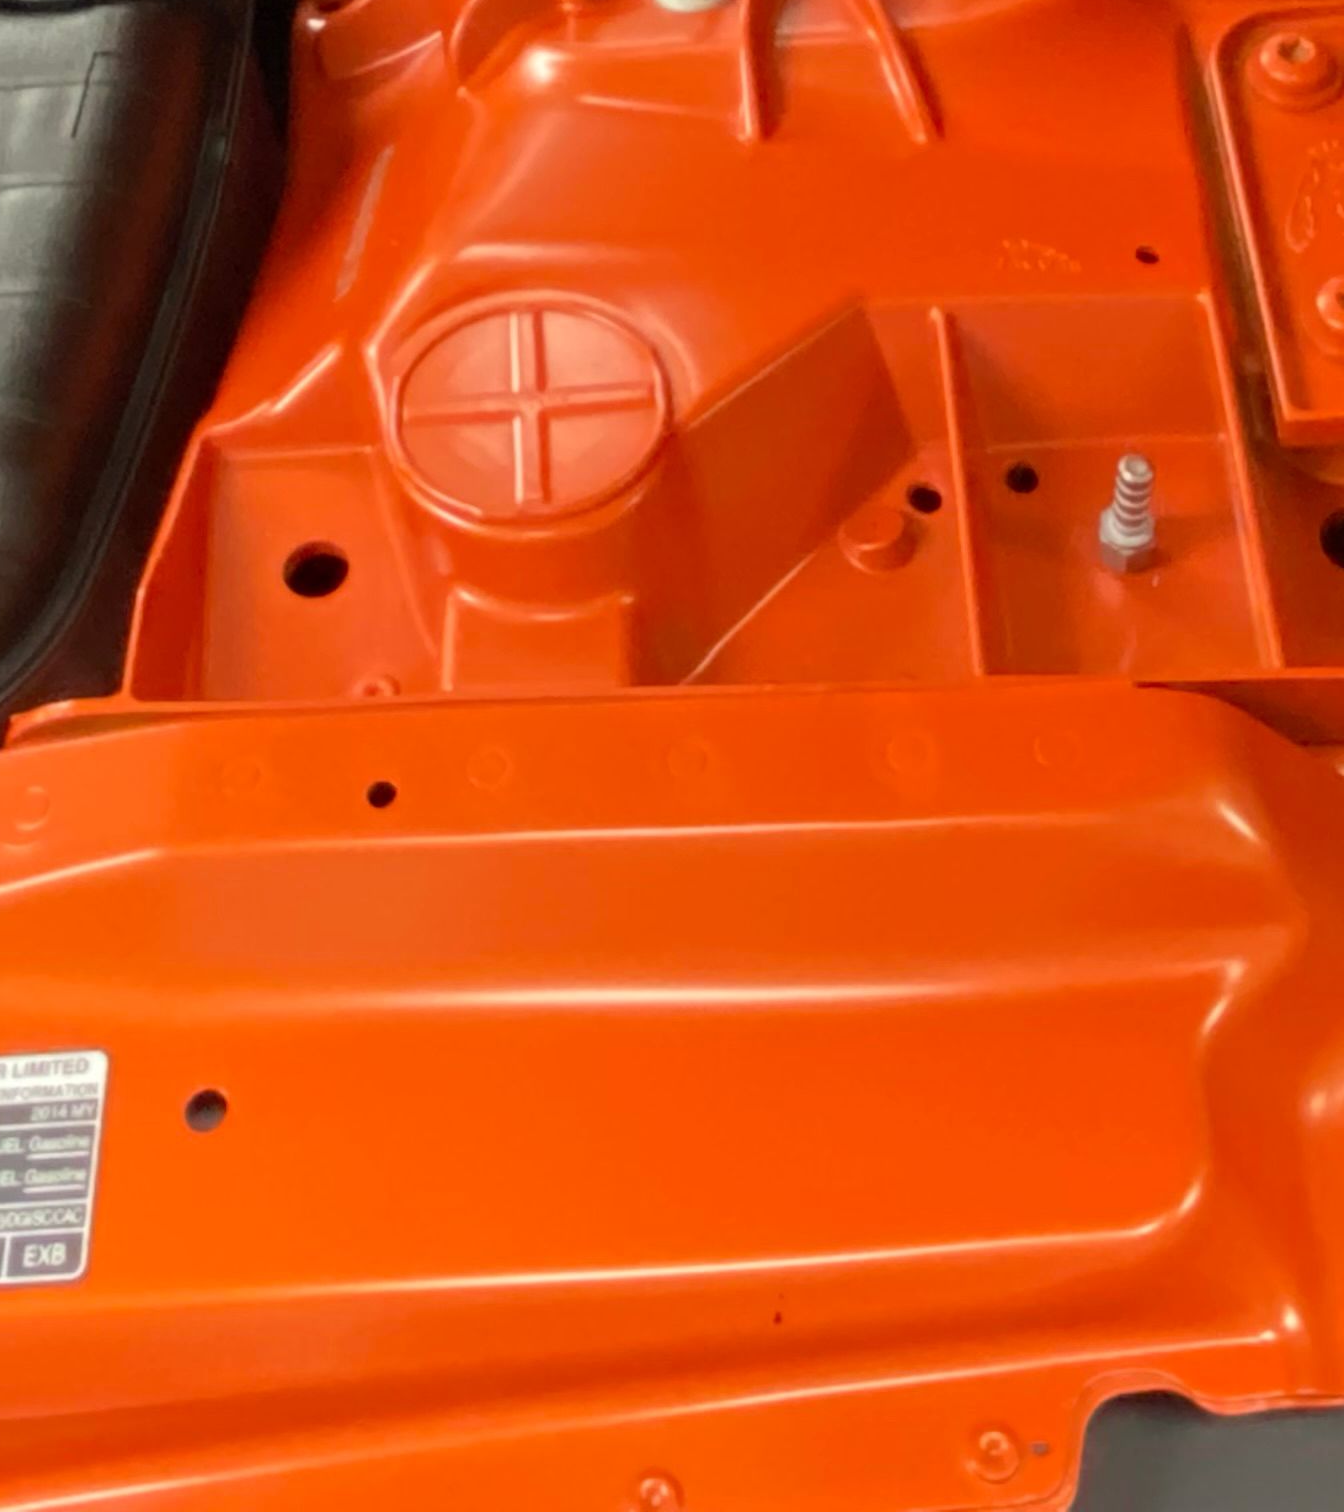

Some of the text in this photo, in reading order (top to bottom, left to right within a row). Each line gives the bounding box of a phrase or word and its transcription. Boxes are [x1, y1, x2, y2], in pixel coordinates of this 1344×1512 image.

[11, 1056, 90, 1078] LIMITED
[30, 1105, 68, 1121] 2014
[28, 1132, 90, 1152] Gasoline
[24, 1166, 86, 1185] Gasoline
